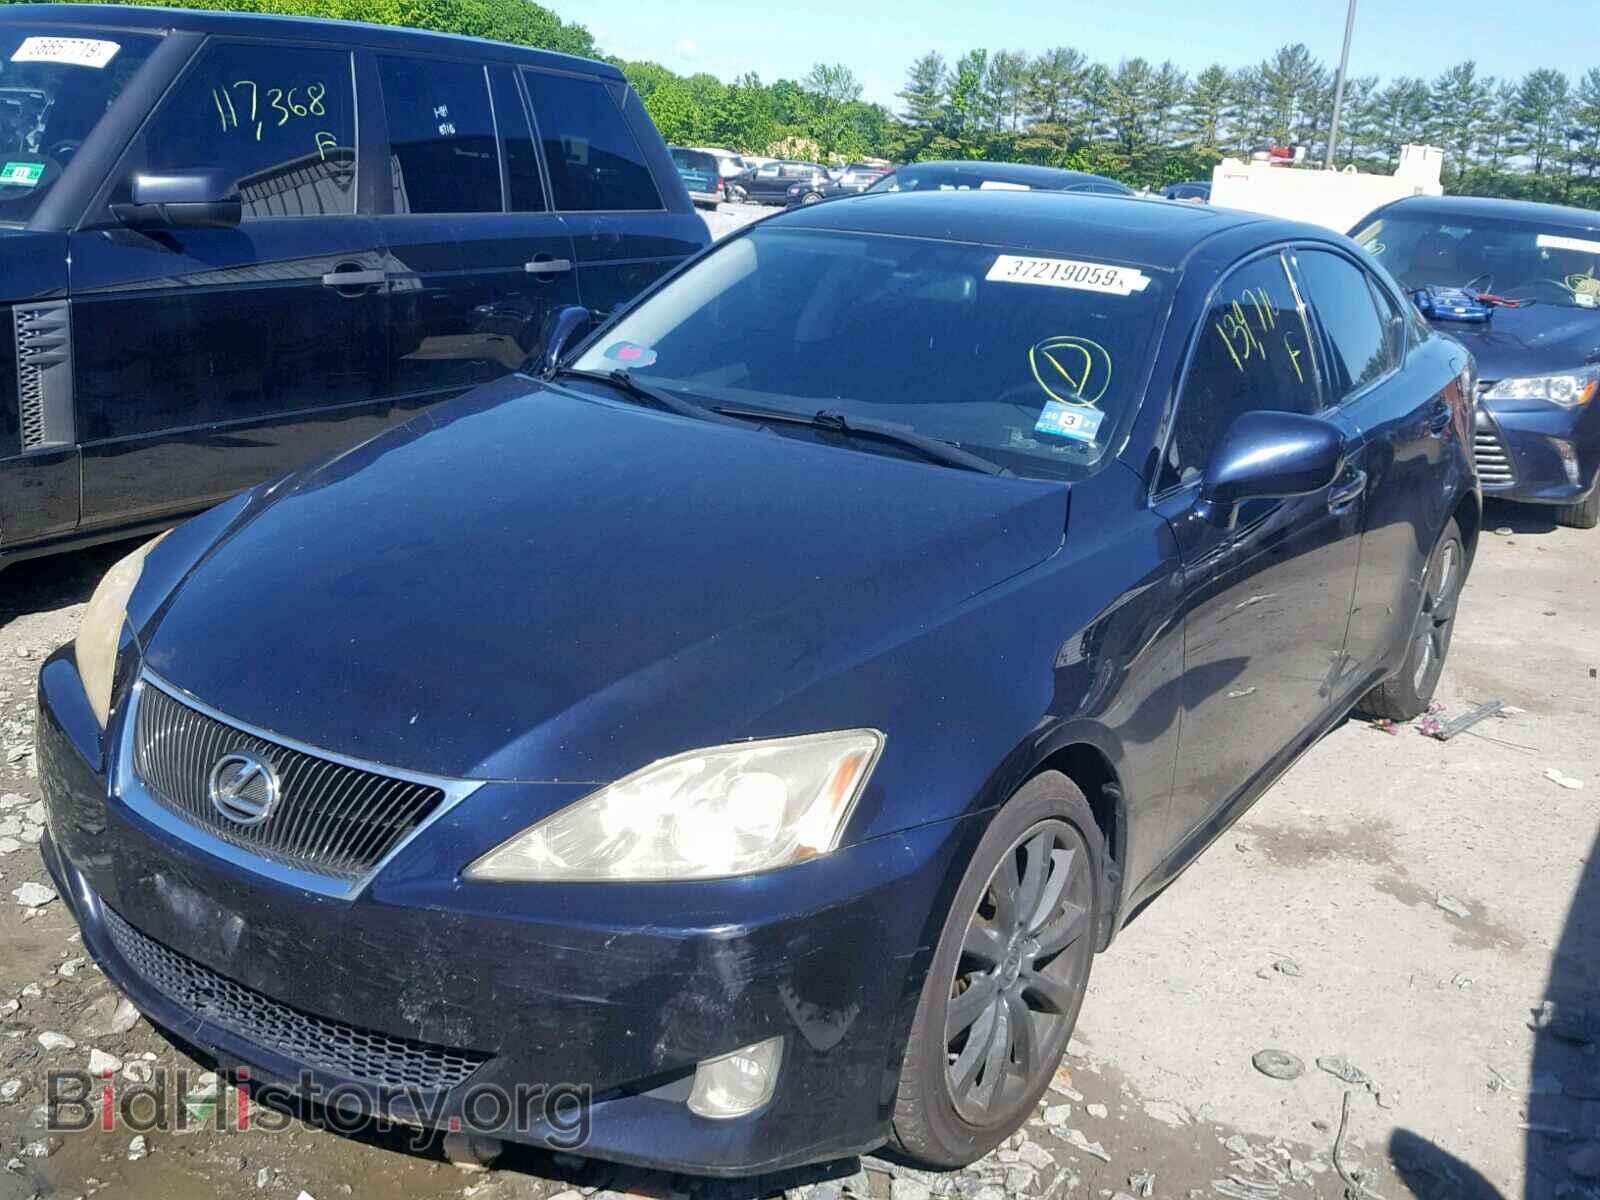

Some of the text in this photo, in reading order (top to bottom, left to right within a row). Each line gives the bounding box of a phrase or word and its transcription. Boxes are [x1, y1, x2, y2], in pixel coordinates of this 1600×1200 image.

[212, 80, 326, 141] 117,368
[314, 131, 338, 160] F
[1007, 260, 1119, 286] 37219059
[1064, 415, 1076, 426] 3
